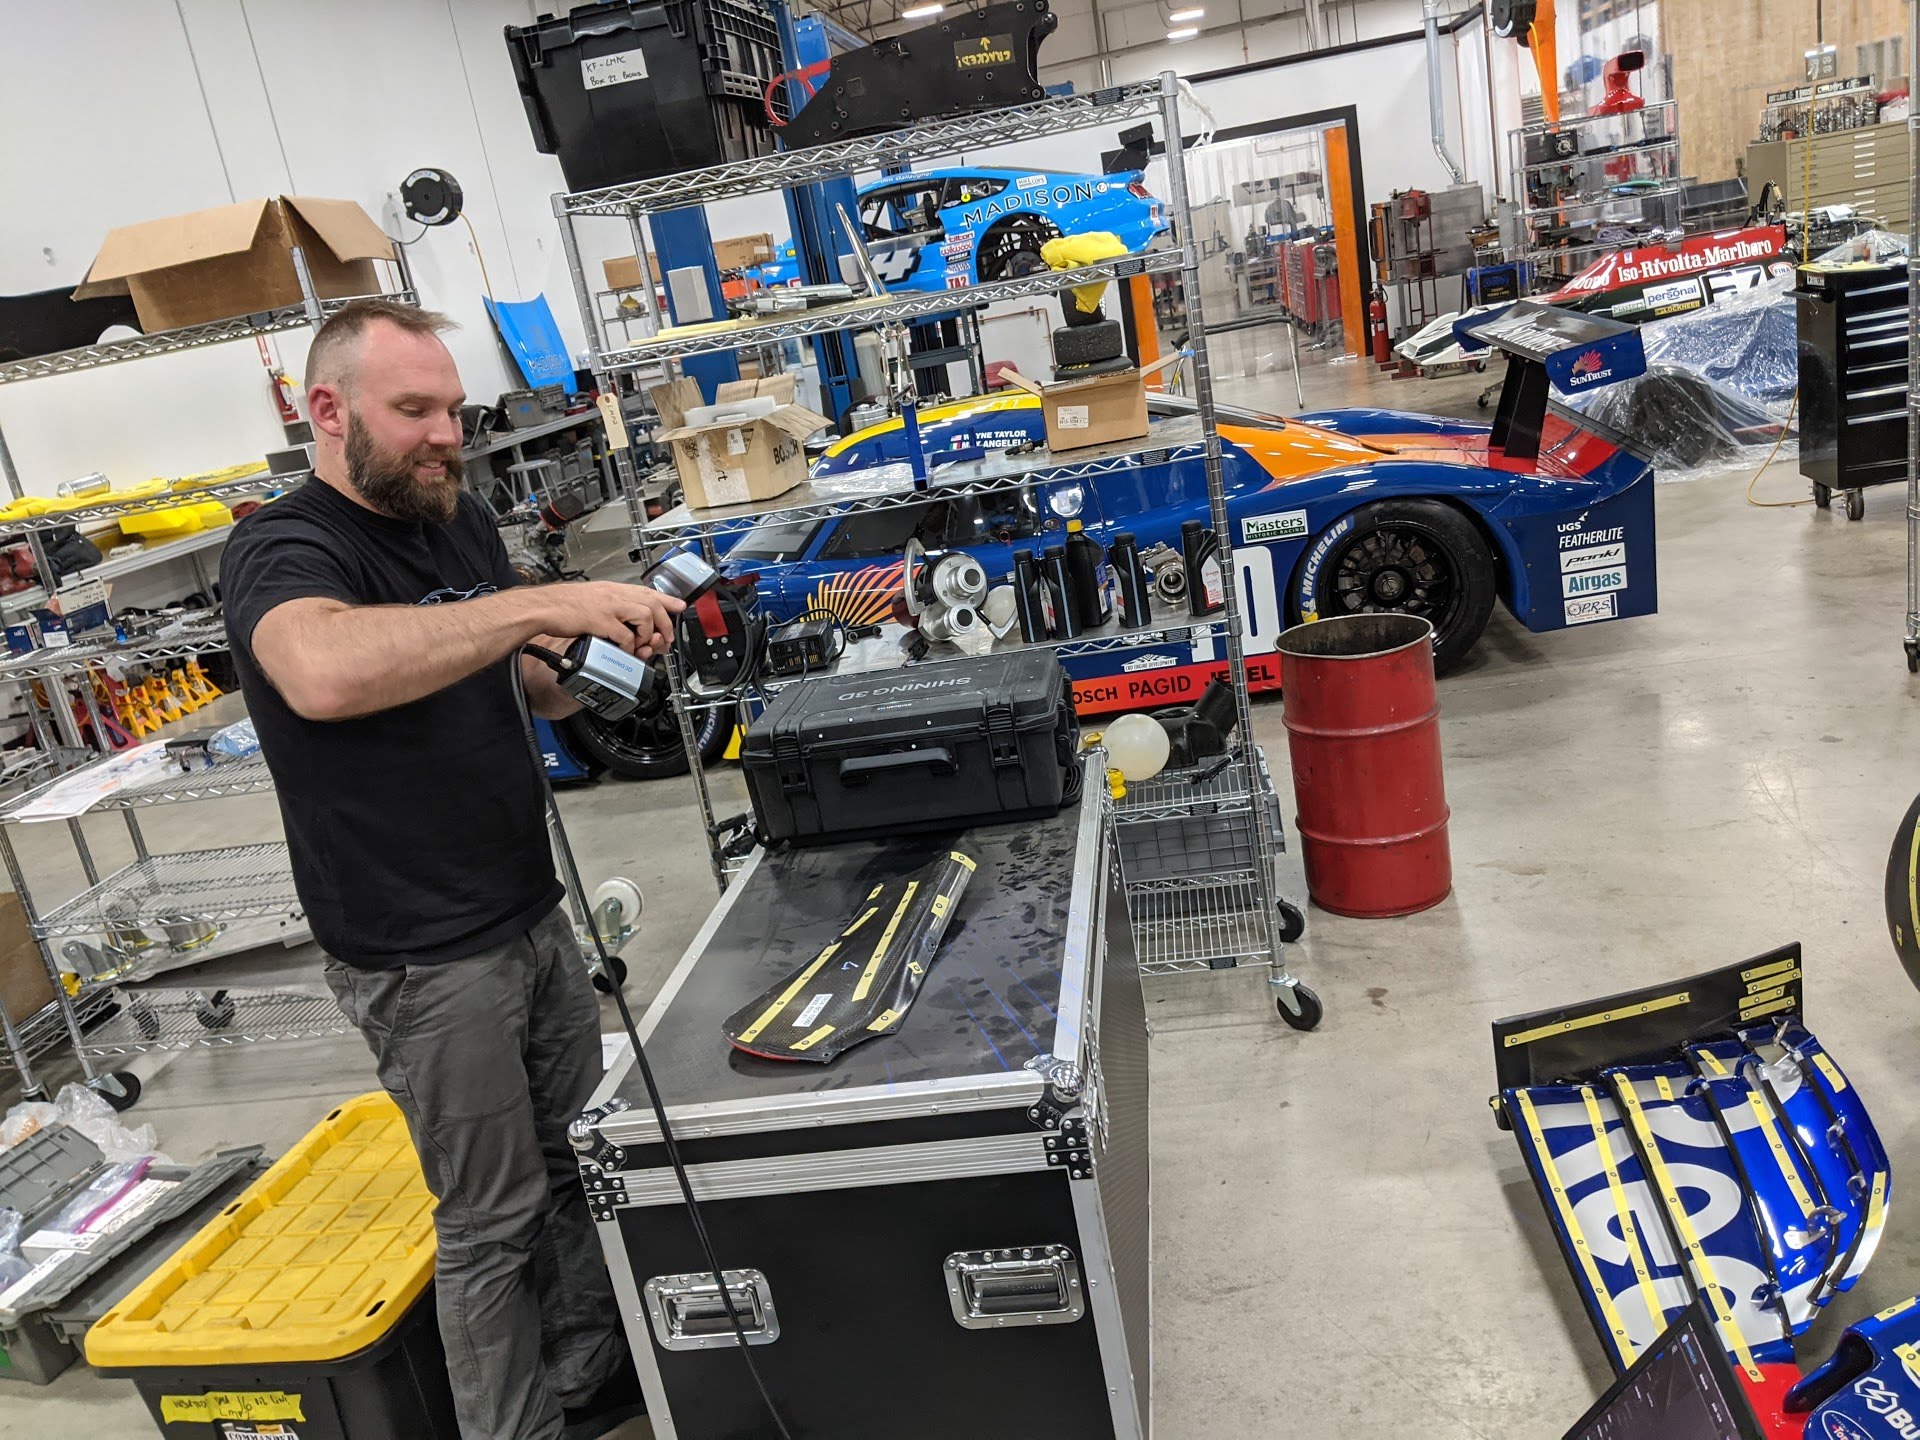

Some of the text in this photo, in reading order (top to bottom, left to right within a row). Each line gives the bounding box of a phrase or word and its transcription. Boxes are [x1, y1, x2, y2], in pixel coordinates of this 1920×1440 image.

[955, 50, 1011, 68] CRACKED!
[962, 180, 1093, 230] MADISON
[1616, 239, 1773, 283] Iso-Rivolta-Marlboro
[1774, 267, 1791, 275] FINA
[948, 276, 967, 290] TA2
[1647, 285, 1697, 305] personal
[963, 429, 1027, 441] WYNE TAYLOR
[1246, 517, 1304, 533] Masters
[1247, 527, 1304, 540] HISTORIC RACING
[1557, 521, 1582, 533] UGS
[1559, 526, 1624, 549] FEATHERLITE
[1302, 520, 1348, 596] MICHELIN
[1568, 572, 1622, 593] Airgas
[872, 677, 972, 696] SHINING
[1072, 664, 1276, 705] OSCH PAGID JEEL
